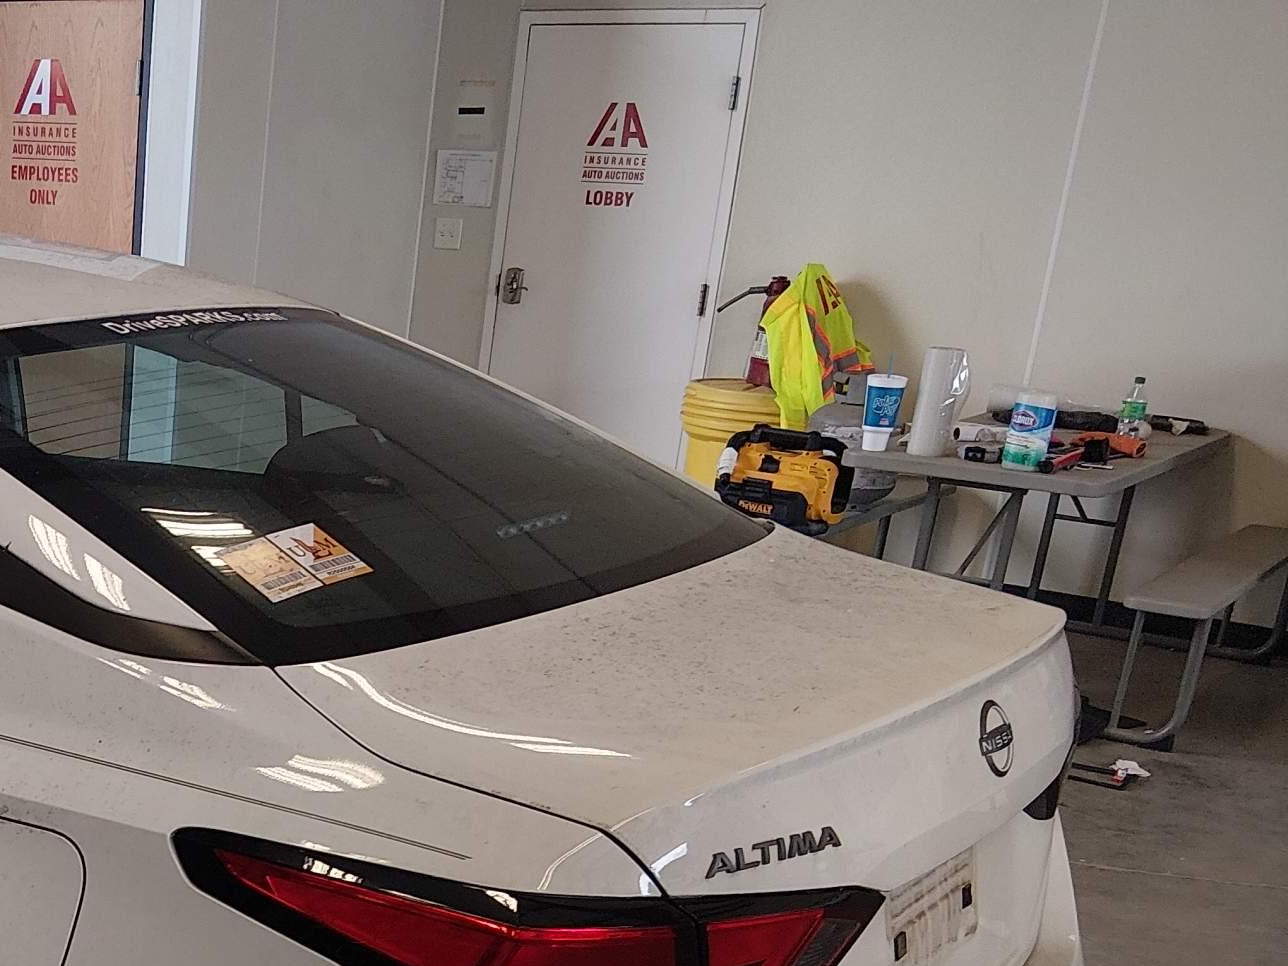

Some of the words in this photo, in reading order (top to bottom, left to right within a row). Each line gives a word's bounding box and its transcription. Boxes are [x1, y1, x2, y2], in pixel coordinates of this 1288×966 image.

[13, 125, 77, 139] INSURANCE
[12, 143, 34, 155] AUTO
[35, 145, 76, 157] AUCTIONS
[584, 155, 647, 167] INSURANCE
[11, 164, 78, 184] EMPLOYEES
[582, 169, 603, 179] AUTO
[604, 171, 645, 182] AUCTIONS
[29, 188, 58, 206] ONLY
[585, 189, 634, 208] LOBBY
[101, 310, 289, 335] DriveSPARKS.com
[705, 826, 842, 879] ALTIMA
